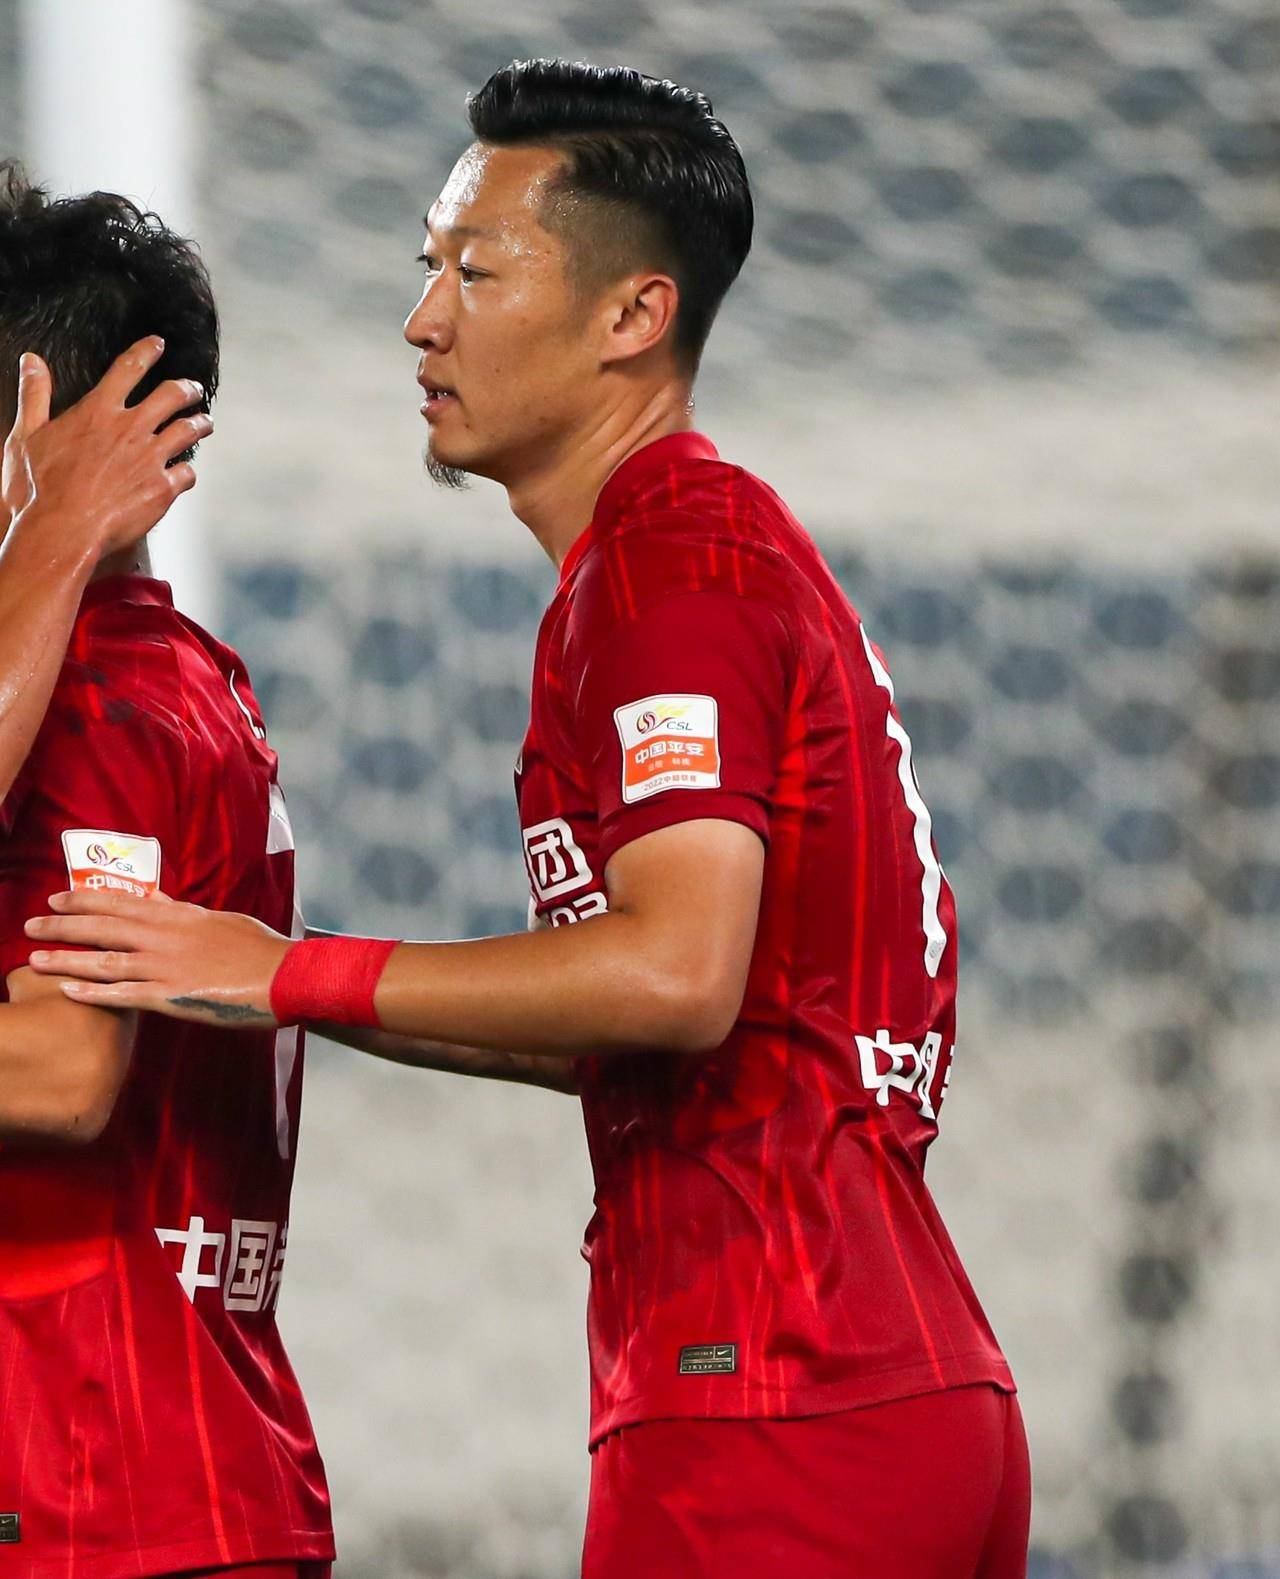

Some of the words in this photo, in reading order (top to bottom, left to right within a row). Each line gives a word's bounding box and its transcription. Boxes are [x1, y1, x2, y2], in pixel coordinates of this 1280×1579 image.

[666, 721, 694, 731] CSL
[634, 740, 705, 764] 中国平安
[115, 861, 136, 874] CSL
